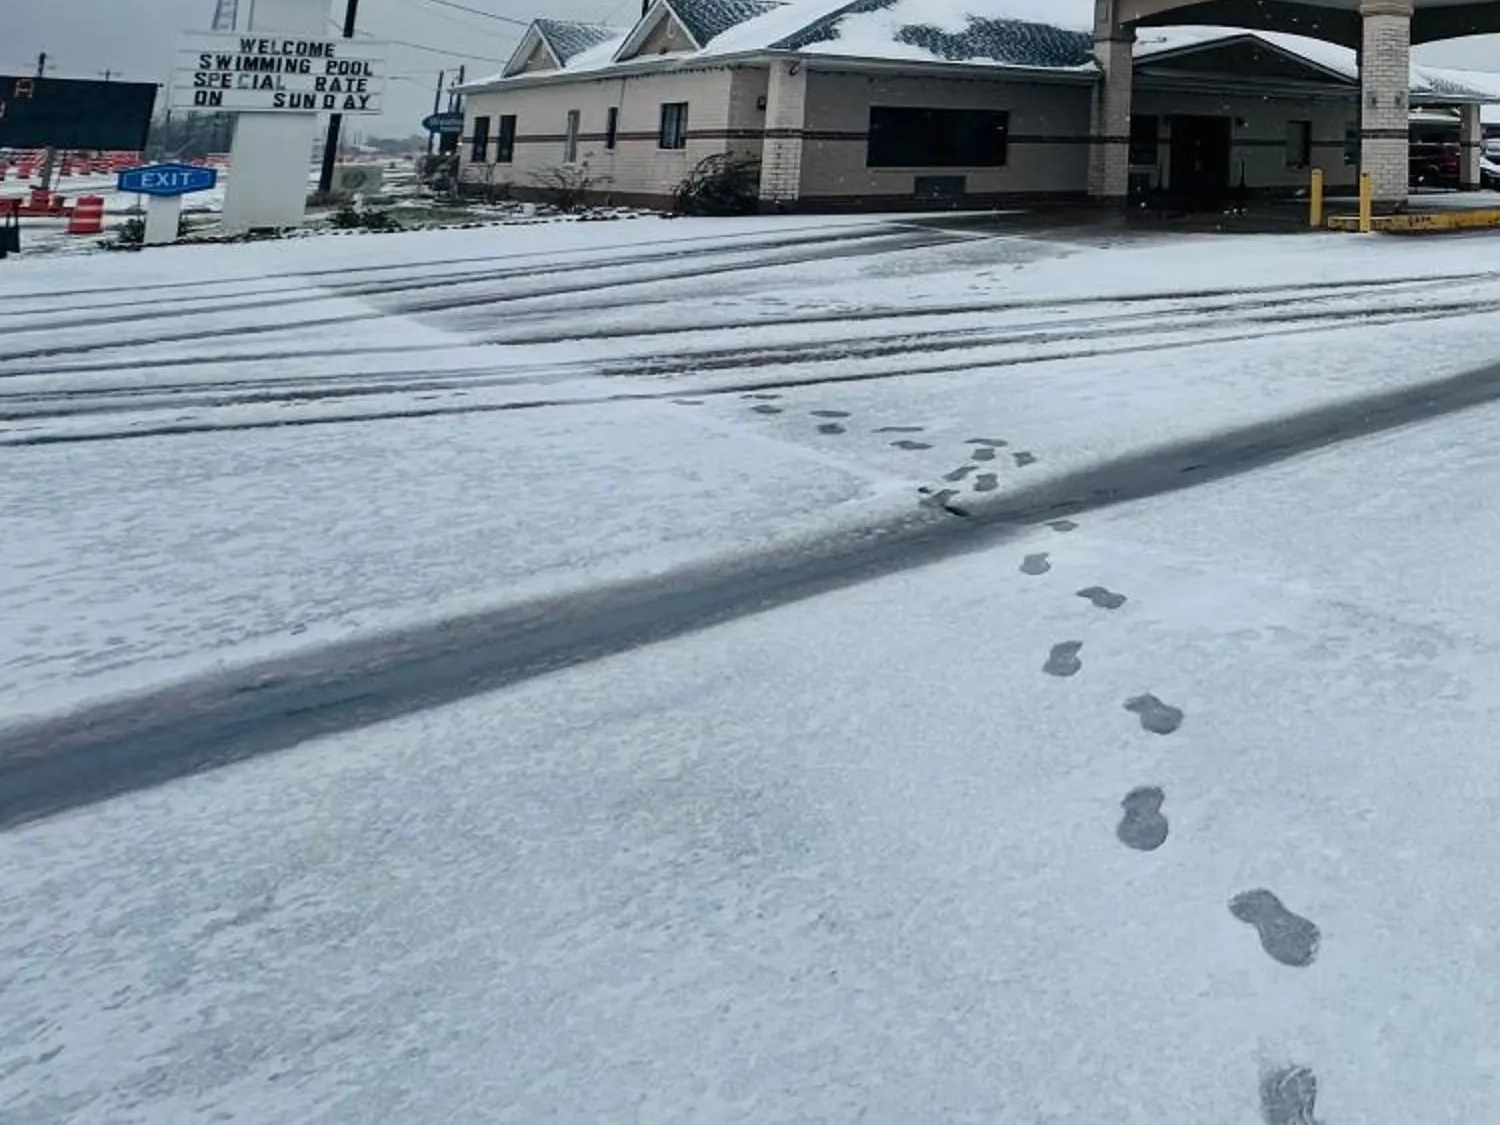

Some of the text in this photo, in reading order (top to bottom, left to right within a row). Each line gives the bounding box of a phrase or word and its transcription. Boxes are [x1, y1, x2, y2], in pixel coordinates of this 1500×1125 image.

[240, 38, 336, 58] WELCOME
[200, 54, 374, 76] SWIMMING POOL
[193, 73, 368, 92] SPECIAL RATE
[194, 91, 371, 110] ON SUNDAY
[141, 172, 192, 187] EXIT
